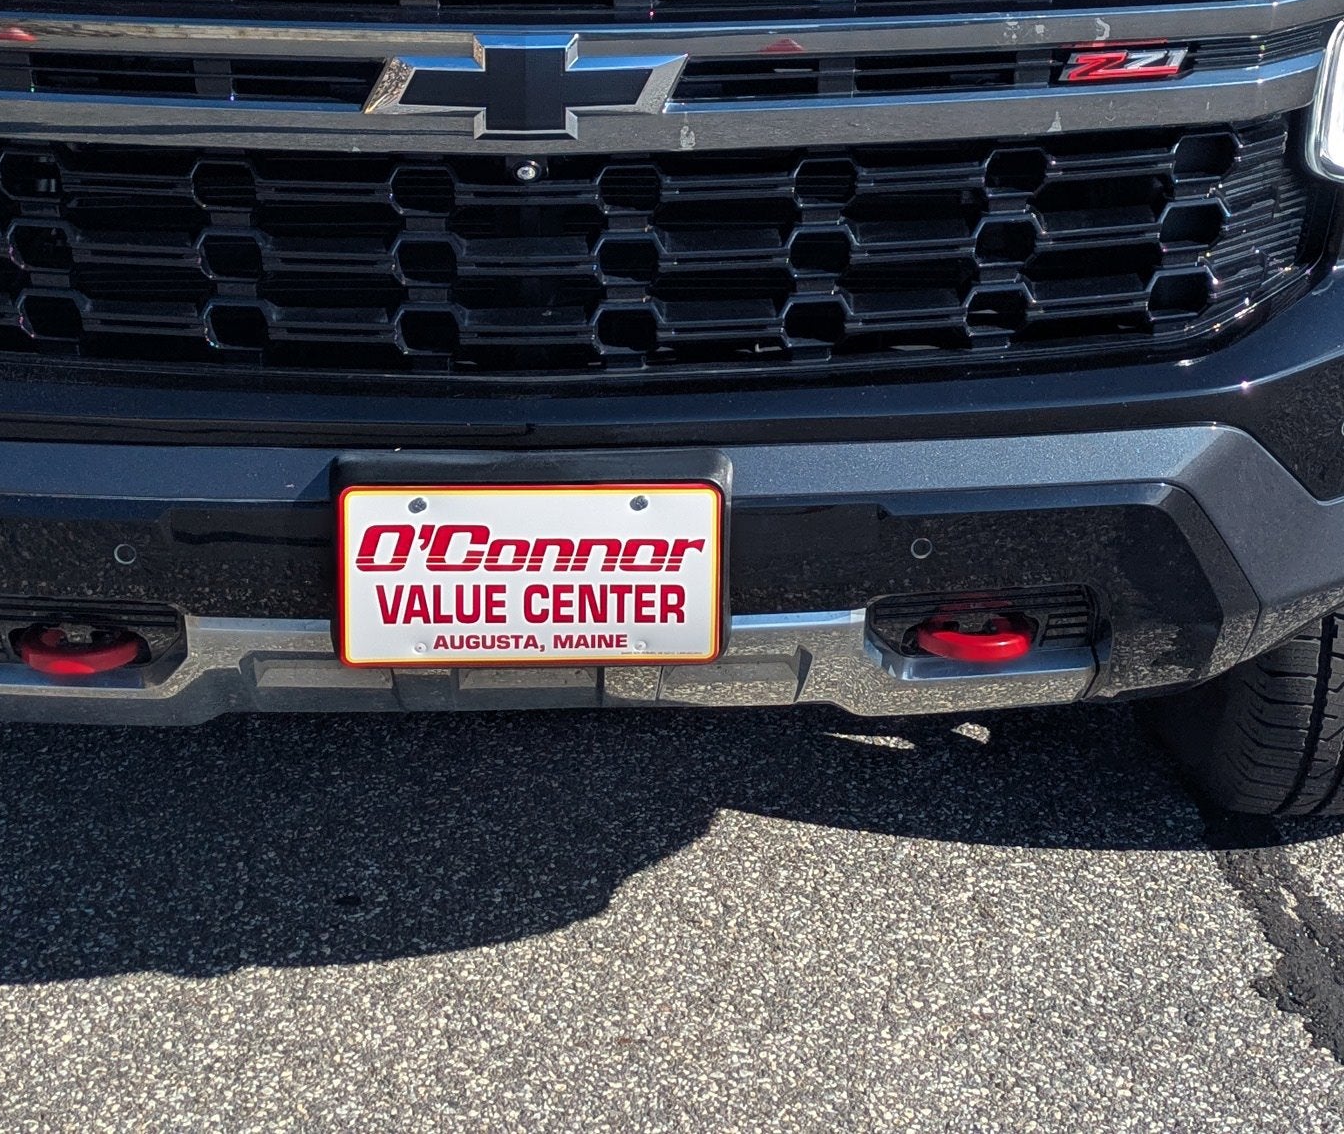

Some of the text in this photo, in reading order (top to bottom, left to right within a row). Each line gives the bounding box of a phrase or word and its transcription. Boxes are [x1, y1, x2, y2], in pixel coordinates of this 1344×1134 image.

[1058, 47, 1188, 81] Z71
[355, 524, 706, 572] O'Connor
[375, 584, 686, 625] VALUE CENTER
[433, 634, 628, 652] AUGUSTA, MAINE
